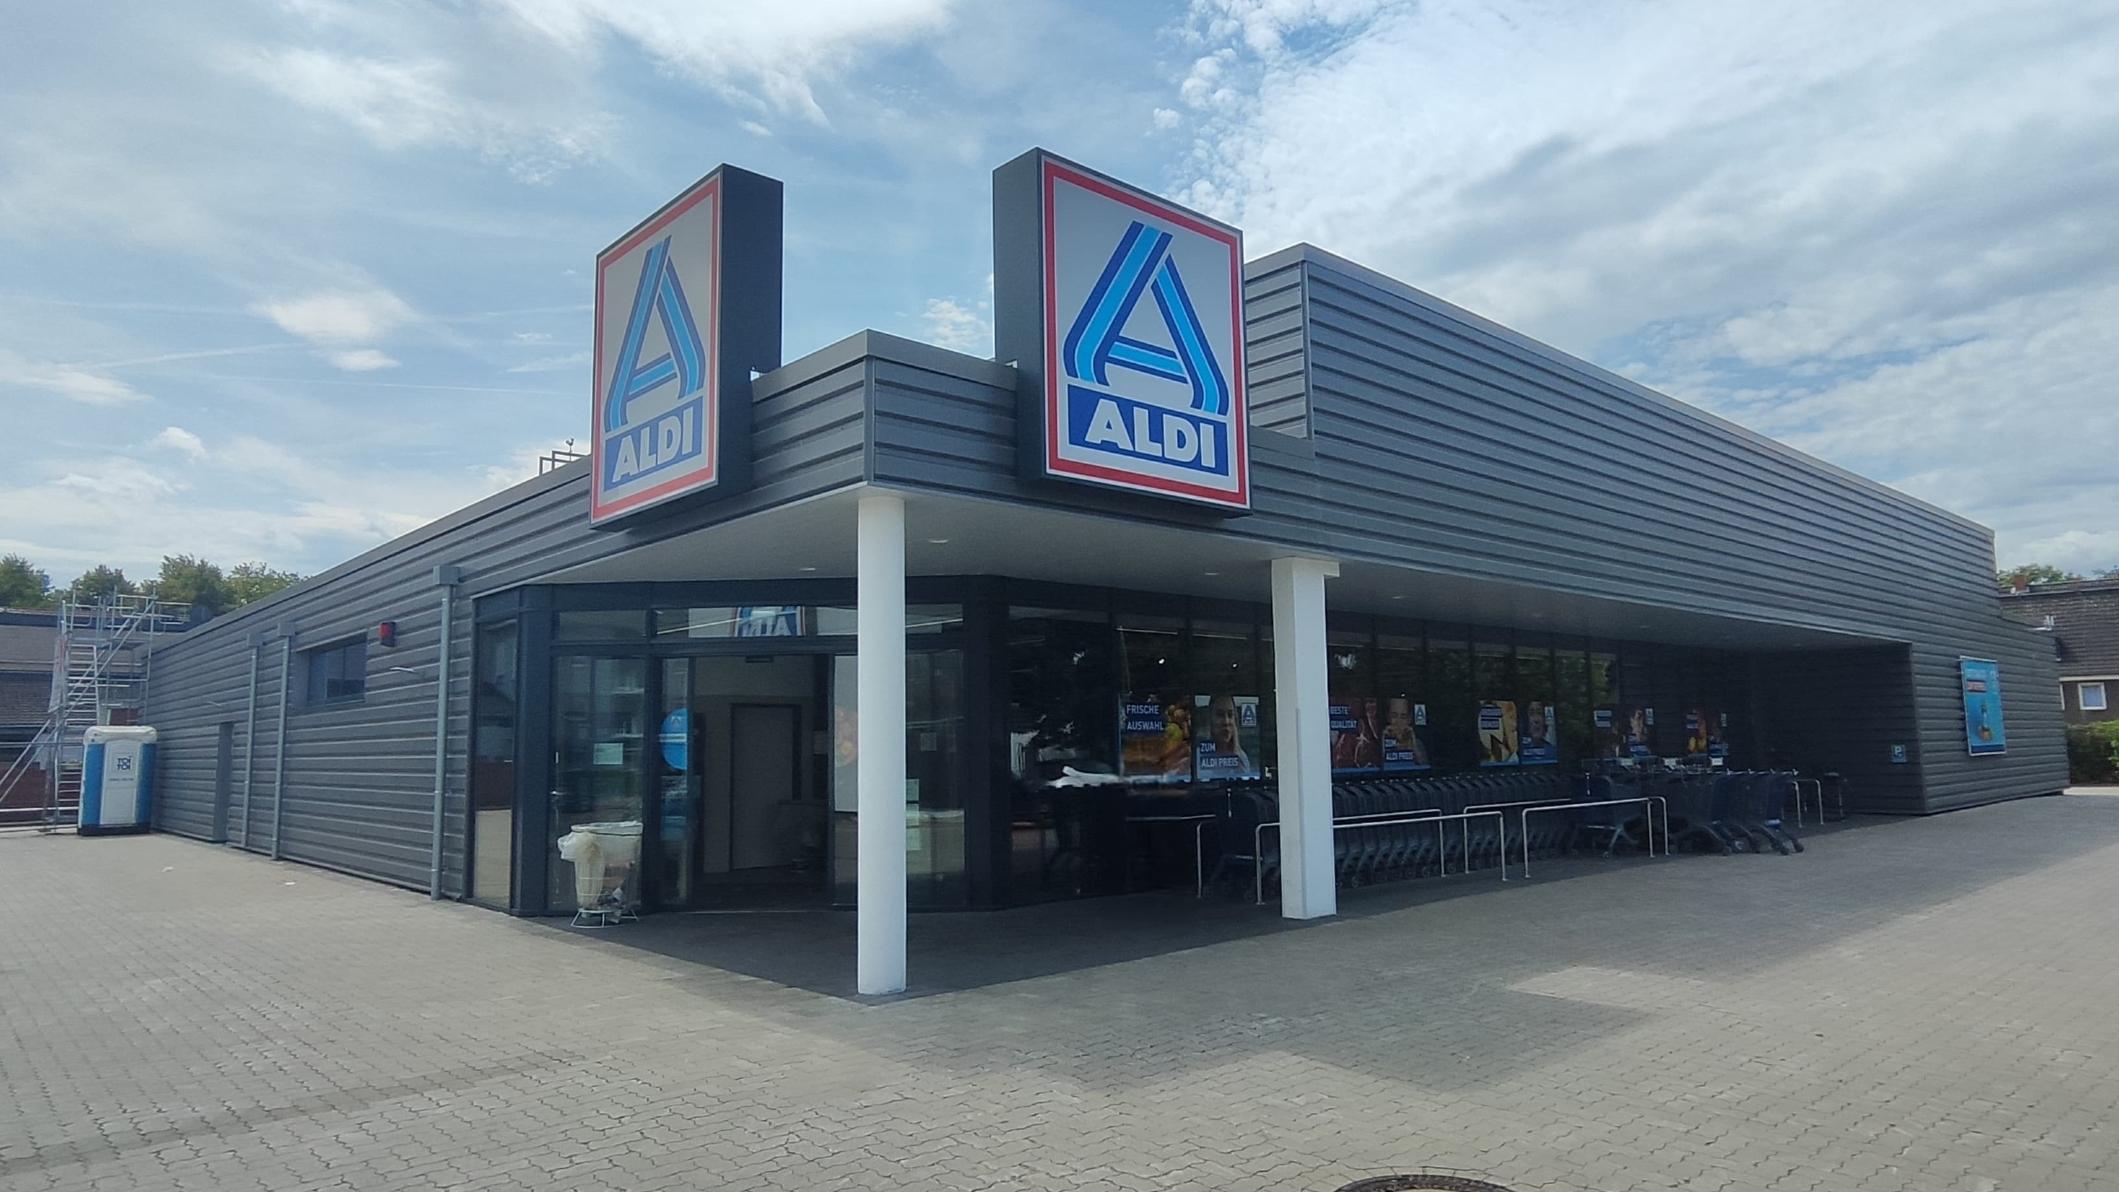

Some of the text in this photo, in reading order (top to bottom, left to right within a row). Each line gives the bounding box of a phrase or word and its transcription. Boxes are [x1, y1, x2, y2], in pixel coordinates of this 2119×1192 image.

[1084, 398, 1216, 468] ALDI
[612, 406, 694, 483] ALDI
[1126, 704, 1160, 715] FRISCHE
[1127, 721, 1164, 731] AUSWAHL
[1200, 742, 1216, 752] ZUM
[1201, 758, 1217, 768] ALDI
